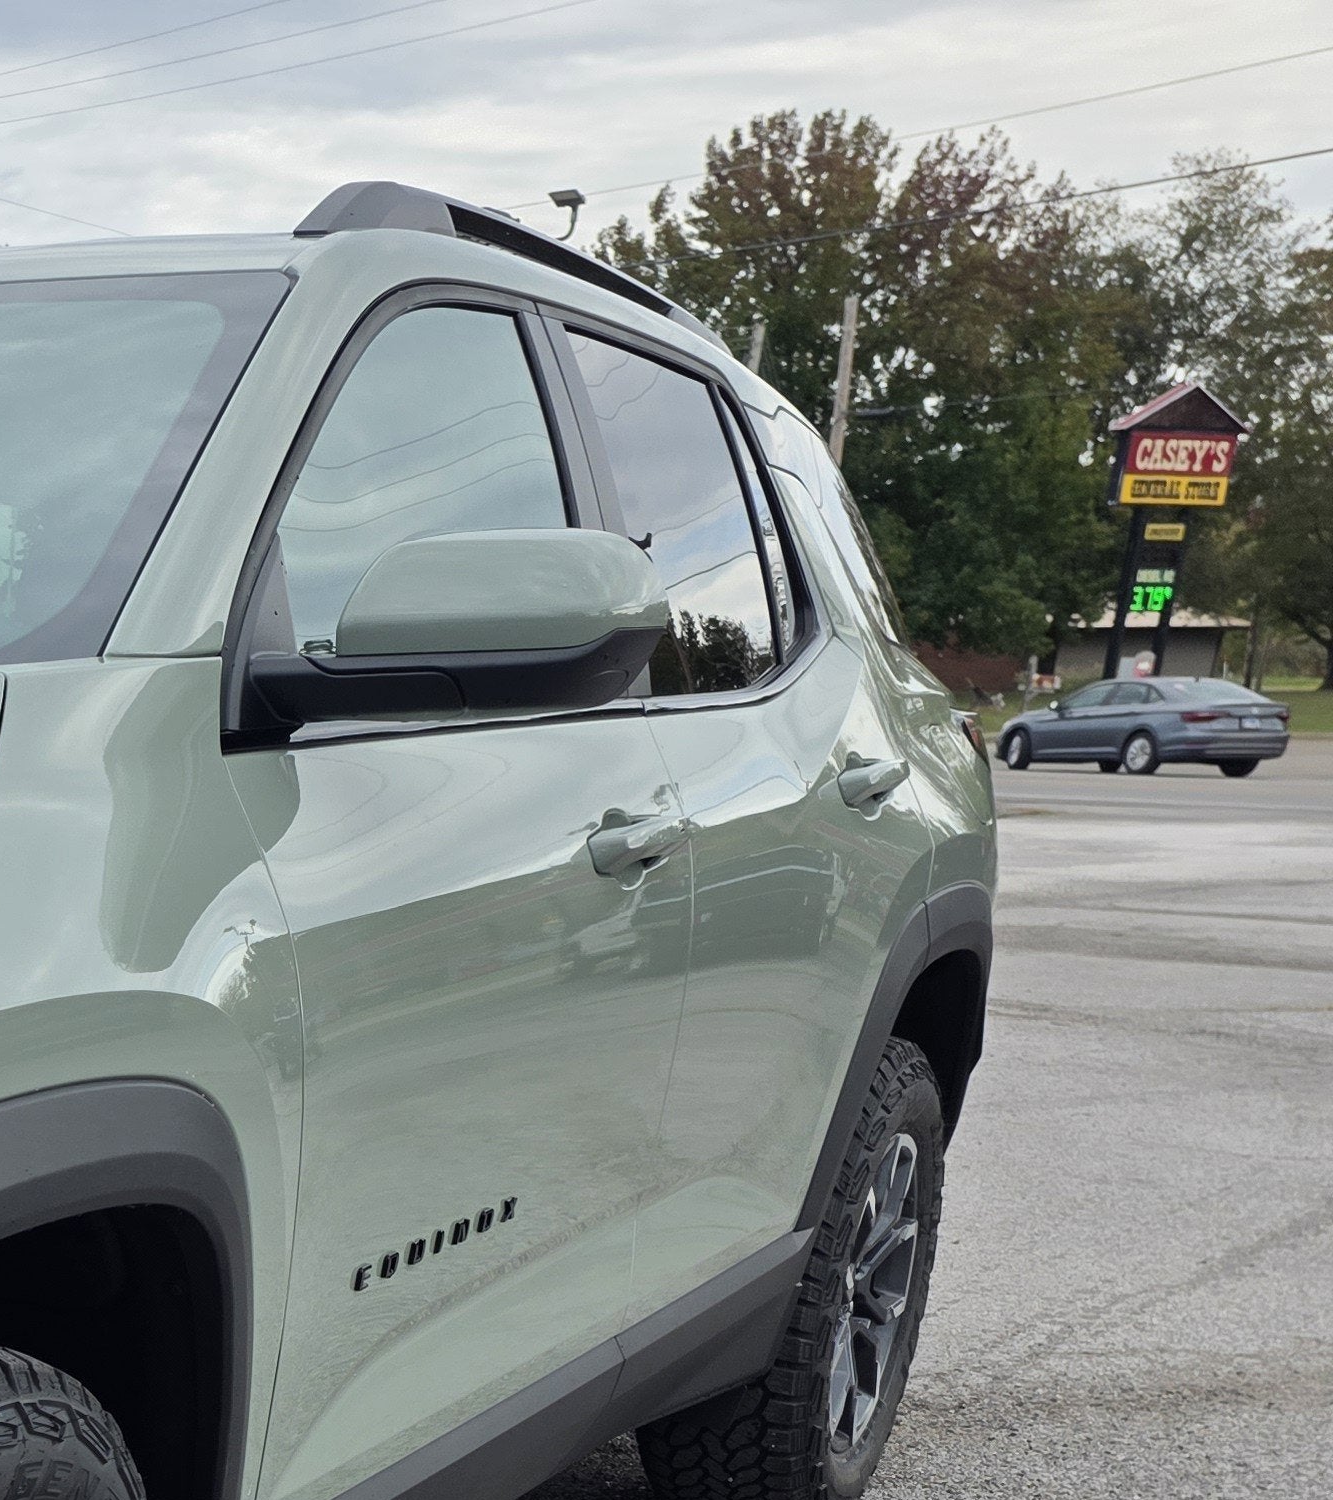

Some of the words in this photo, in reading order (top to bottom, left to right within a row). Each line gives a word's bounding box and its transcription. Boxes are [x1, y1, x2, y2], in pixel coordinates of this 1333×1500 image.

[1135, 438, 1231, 472] CASEY'S
[1131, 479, 1180, 499] GENERAL
[1184, 481, 1221, 500] STORE
[351, 1196, 519, 1292] EQUINOX
